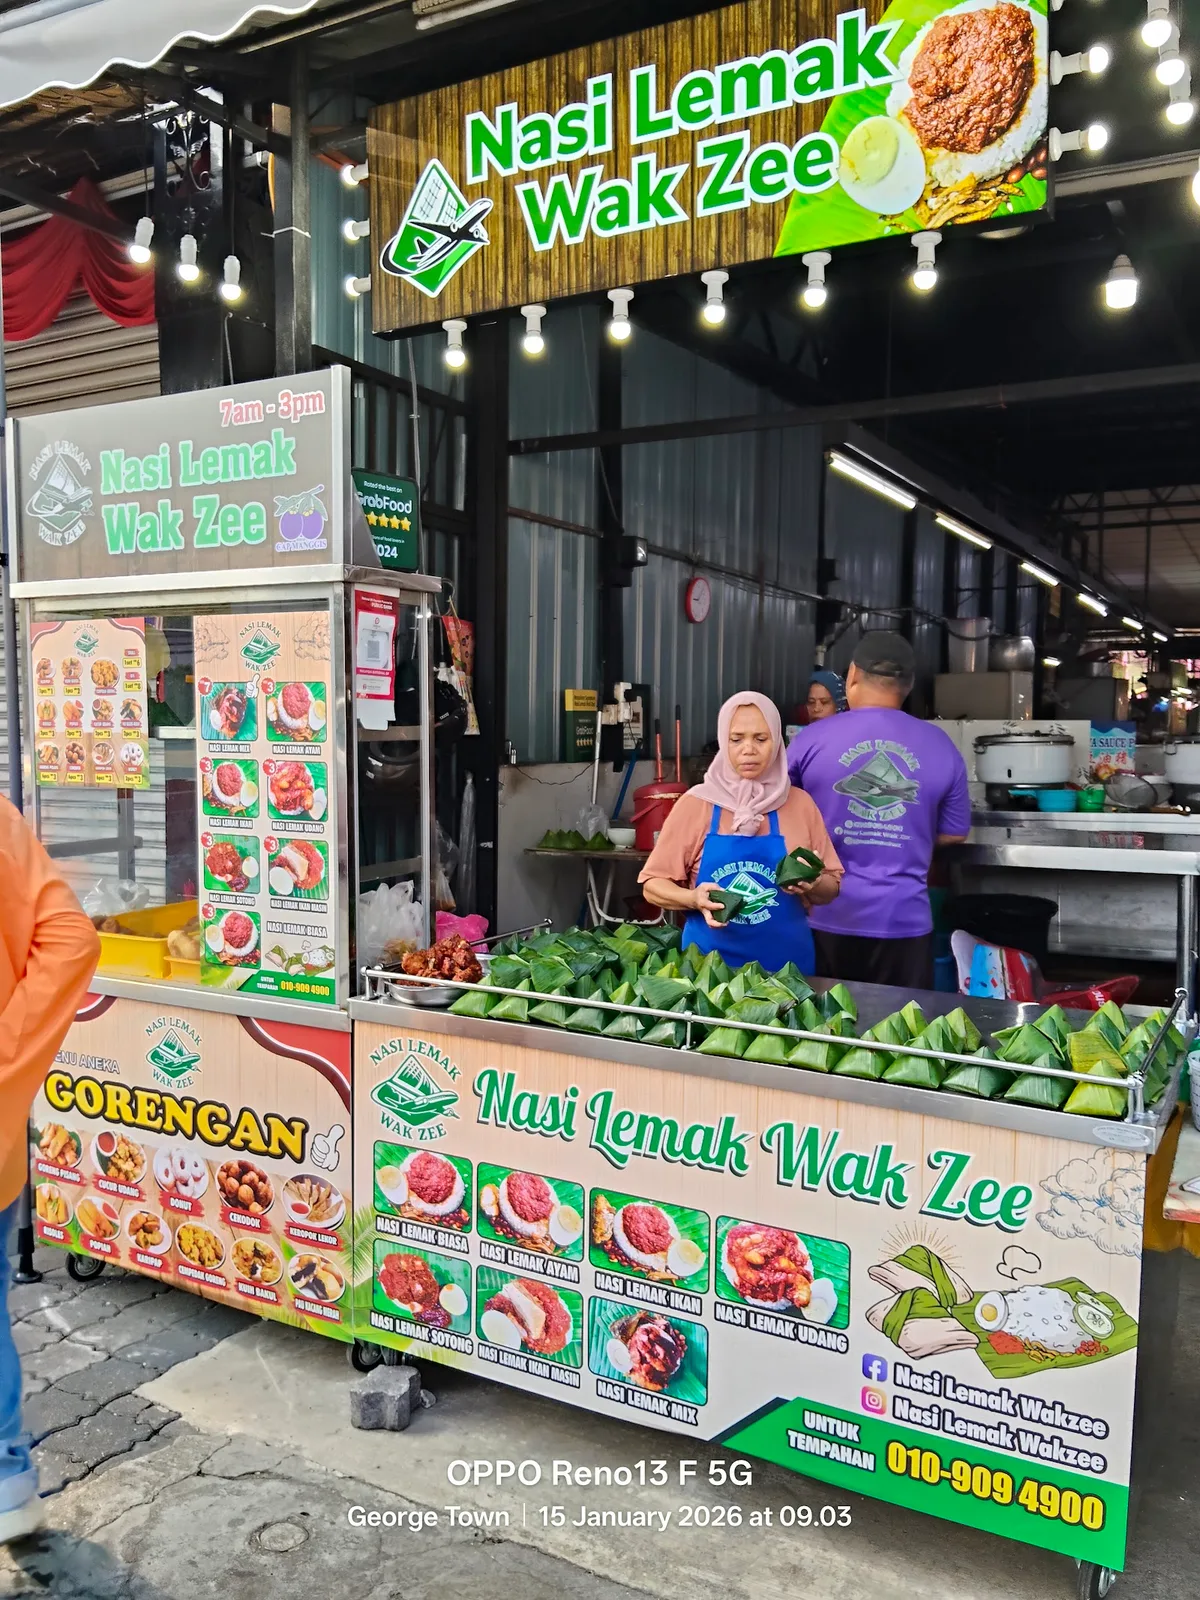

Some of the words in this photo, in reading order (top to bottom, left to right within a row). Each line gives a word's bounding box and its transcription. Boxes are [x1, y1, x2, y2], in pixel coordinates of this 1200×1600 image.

[467, 73, 612, 184] Nasi
[630, 8, 904, 143] Lemak
[516, 155, 688, 251] Wak
[698, 131, 839, 217] Zee
[220, 399, 263, 427] 7am
[279, 390, 325, 423] 3pm
[29, 444, 53, 481] NASI
[54, 440, 92, 476] LEMAK
[100, 443, 172, 494] Nasi
[179, 429, 296, 487] Lemak
[39, 522, 62, 546] WAK
[64, 519, 86, 545] ZEE
[103, 501, 184, 554] Wak
[193, 495, 267, 549] Zee
[276, 543, 292, 552] CAP
[292, 539, 327, 551] MANGGIS
[375, 544, 398, 558] 024
[239, 622, 255, 638] NASI
[257, 621, 282, 638] LEMAK
[245, 661, 261, 672] WAK
[263, 661, 276, 671] ZEE
[209, 743, 220, 752] NASI
[222, 744, 239, 753] LEMAK
[273, 745, 285, 754] NASI
[286, 745, 304, 755] LEMAK
[305, 745, 321, 755] AYAM
[839, 740, 873, 768] NASI
[874, 739, 920, 772] LEMAK
[1099, 738, 1127, 748] SAUCE
[209, 818, 221, 826] NASI
[222, 819, 239, 828] LEMAK
[847, 800, 877, 821] WAK
[879, 804, 906, 821] ZEE
[272, 822, 285, 831] NASI
[286, 823, 304, 832] LEMAK
[305, 824, 324, 833] UDANG
[711, 862, 737, 883] NASI
[209, 893, 220, 902] NASI
[221, 894, 236, 904] LEMAK
[282, 900, 298, 911] LEMAK
[730, 915, 748, 924] AK
[749, 909, 771, 924] ZEE
[267, 922, 282, 932] NASI
[284, 923, 306, 935] LEMAK
[307, 925, 327, 938] BIASA
[281, 981, 310, 993] 010-909
[311, 985, 329, 996] 4900
[145, 1017, 166, 1036] NASI
[169, 1017, 202, 1046] LEMAK
[55, 1050, 77, 1066] ENU
[79, 1054, 120, 1074] ANEKA
[370, 1038, 403, 1066] NASI
[408, 1039, 461, 1082] LEMAK
[153, 1069, 173, 1088] WAK
[176, 1076, 194, 1089] ZEE
[44, 1070, 308, 1163] GORENGAN
[380, 1111, 412, 1139] WAK
[418, 1123, 447, 1140] ZEE
[473, 1068, 579, 1141] Nasi
[585, 1088, 757, 1177] Lemak
[760, 1120, 915, 1209] Wak
[919, 1149, 1033, 1233] Zee
[37, 1163, 59, 1177] GORENG
[60, 1167, 80, 1182] PISANG
[98, 1179, 118, 1192] CUCUR
[118, 1184, 140, 1198] UDANG
[169, 1197, 193, 1212] DONUT
[229, 1212, 261, 1229] CEKODOK
[289, 1227, 317, 1242] KEROPOK
[317, 1233, 338, 1246] LEKOR
[376, 1216, 400, 1235] NASI
[401, 1221, 437, 1243] LEMAK
[437, 1229, 469, 1253] BIASA
[136, 1253, 163, 1268] KARIPAP
[480, 1242, 506, 1264] NASI
[507, 1248, 546, 1274] LEMAK
[546, 1257, 580, 1283] AYAM
[238, 1282, 255, 1296] KUIH
[255, 1286, 278, 1303] BAKUL
[595, 1272, 623, 1296] NASI
[626, 1280, 668, 1306] LEMAK
[669, 1290, 702, 1316] IKAN
[371, 1312, 394, 1332] NASI
[395, 1319, 430, 1343] LEMAK
[431, 1329, 473, 1354] SOTONG
[715, 1302, 747, 1327] NASI
[749, 1310, 796, 1341] LEMAK
[797, 1323, 849, 1354] UDANG
[478, 1344, 498, 1362] NASI
[499, 1348, 527, 1371] LEMAK
[528, 1356, 550, 1378] IKAN
[550, 1365, 580, 1388] MASIN
[597, 1380, 625, 1404] NASI
[627, 1388, 669, 1416] LEMAK
[670, 1401, 698, 1426] MIX
[894, 1363, 941, 1395] Nasi
[945, 1377, 1019, 1417] Lemak
[1019, 1392, 1109, 1439] Wakzee
[802, 1408, 861, 1444] UNTUK
[893, 1397, 940, 1428] Nasi
[943, 1411, 1018, 1450] Lemak
[1017, 1431, 1107, 1474] Wakzee
[787, 1429, 876, 1473] TEMPAHAN
[886, 1440, 1014, 1506] 010-909
[1018, 1479, 1106, 1532] 4900
